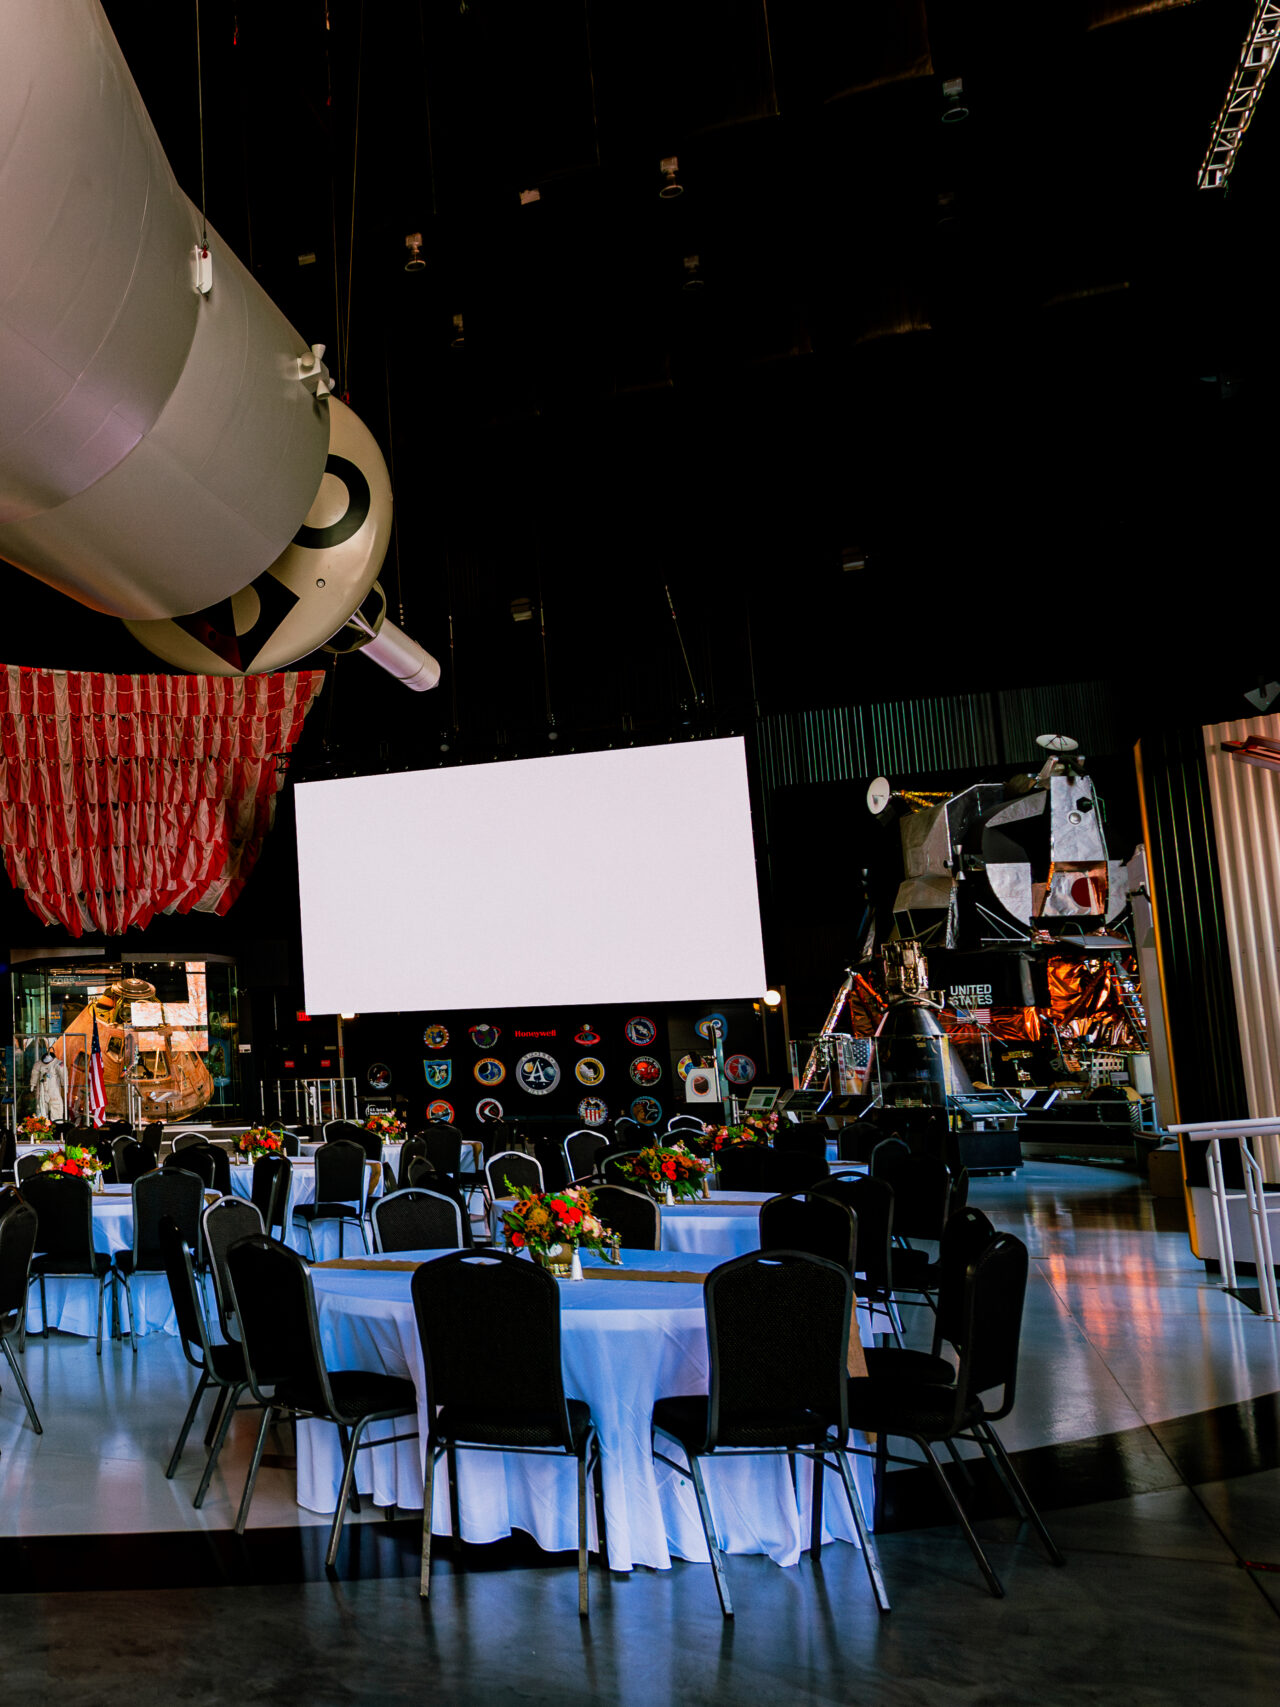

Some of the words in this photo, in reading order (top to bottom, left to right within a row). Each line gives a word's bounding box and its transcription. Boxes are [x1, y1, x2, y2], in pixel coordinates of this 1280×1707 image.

[950, 984, 992, 995] UNITED
[951, 994, 993, 1005] STATES
[514, 1029, 557, 1038] Honeywell
[521, 1052, 556, 1065] APOLLO
